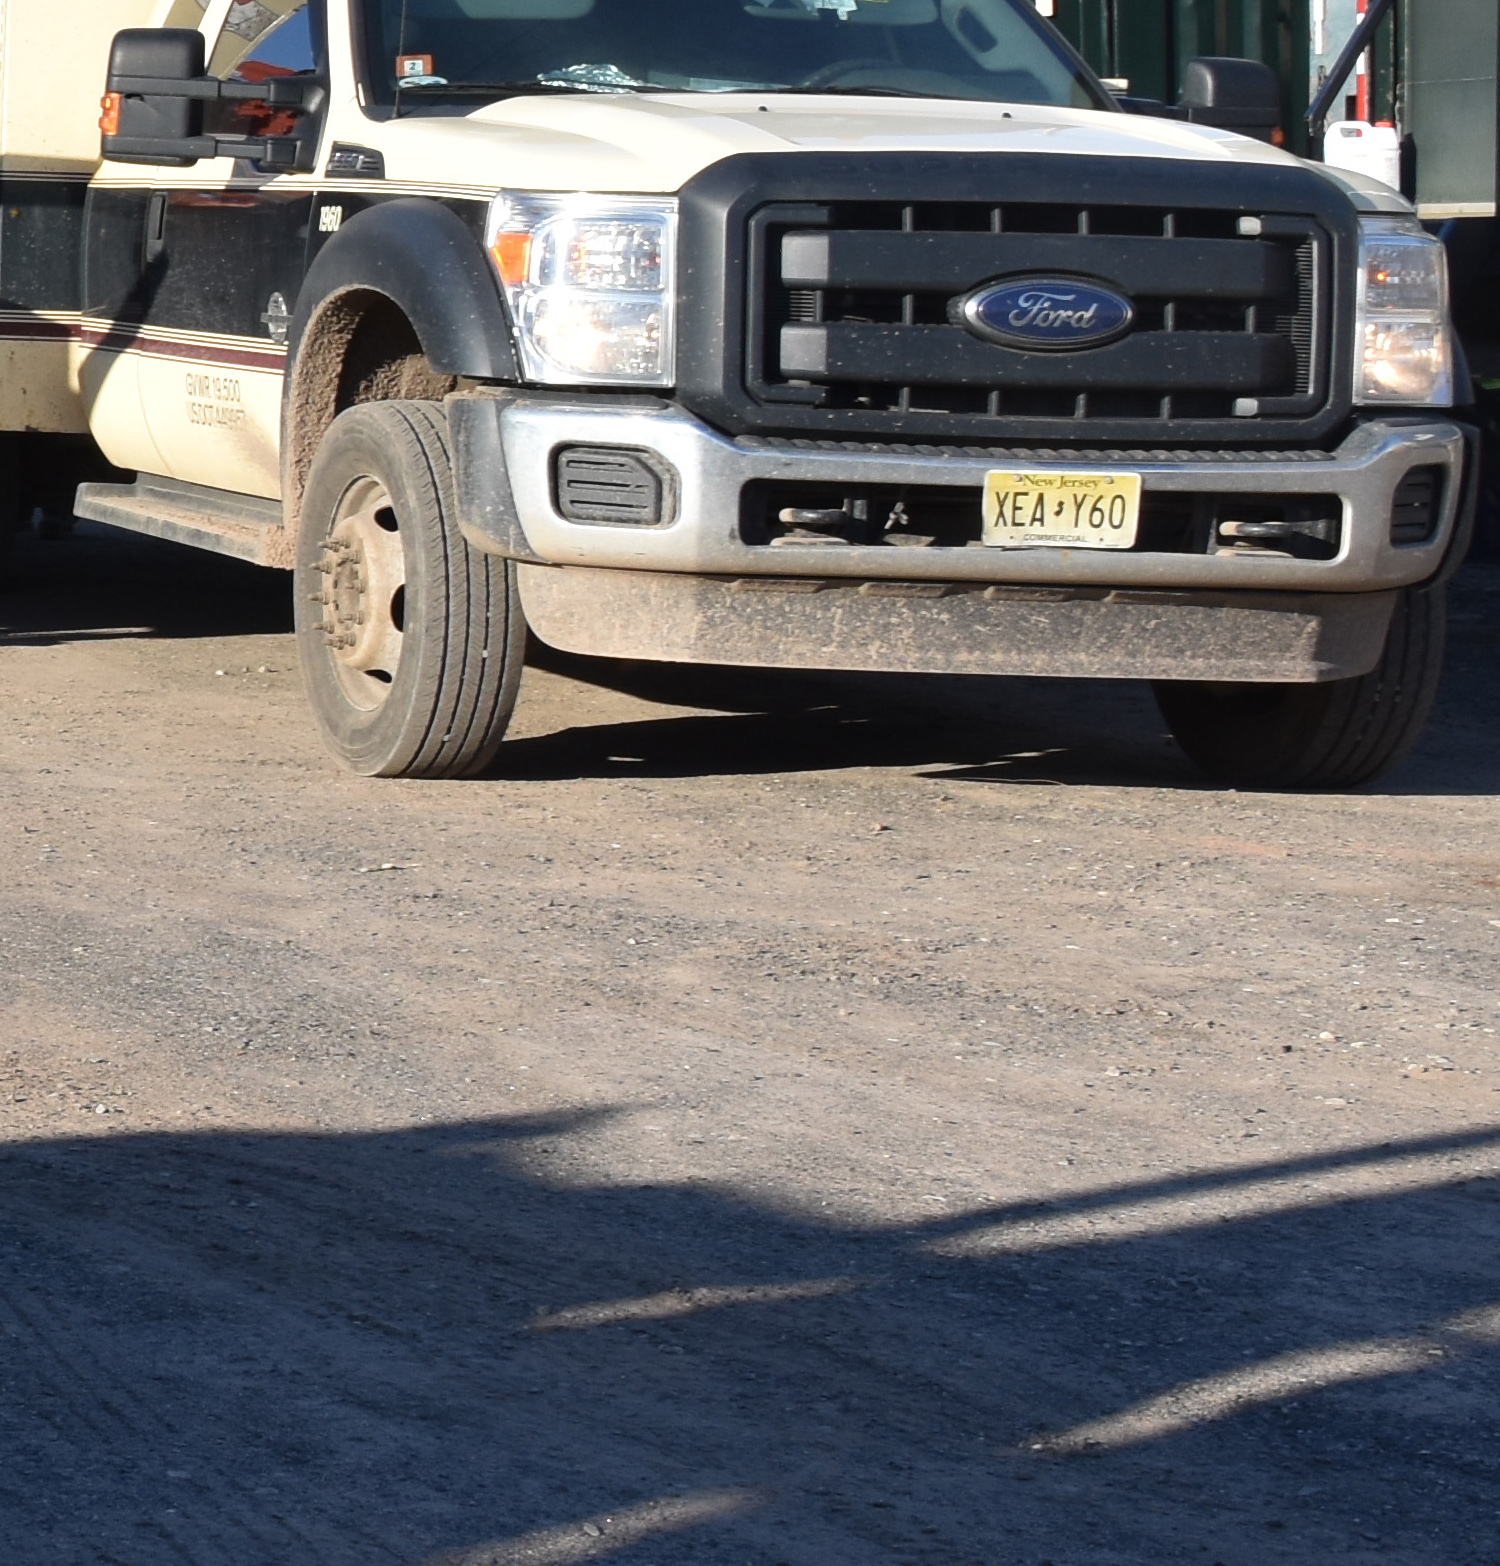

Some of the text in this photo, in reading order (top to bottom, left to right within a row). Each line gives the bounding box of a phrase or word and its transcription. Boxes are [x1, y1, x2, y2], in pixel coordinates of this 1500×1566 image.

[1008, 291, 1099, 329] Ford
[1022, 474, 1100, 489] New Jersey
[1023, 533, 1088, 543] COMMERCIAL
